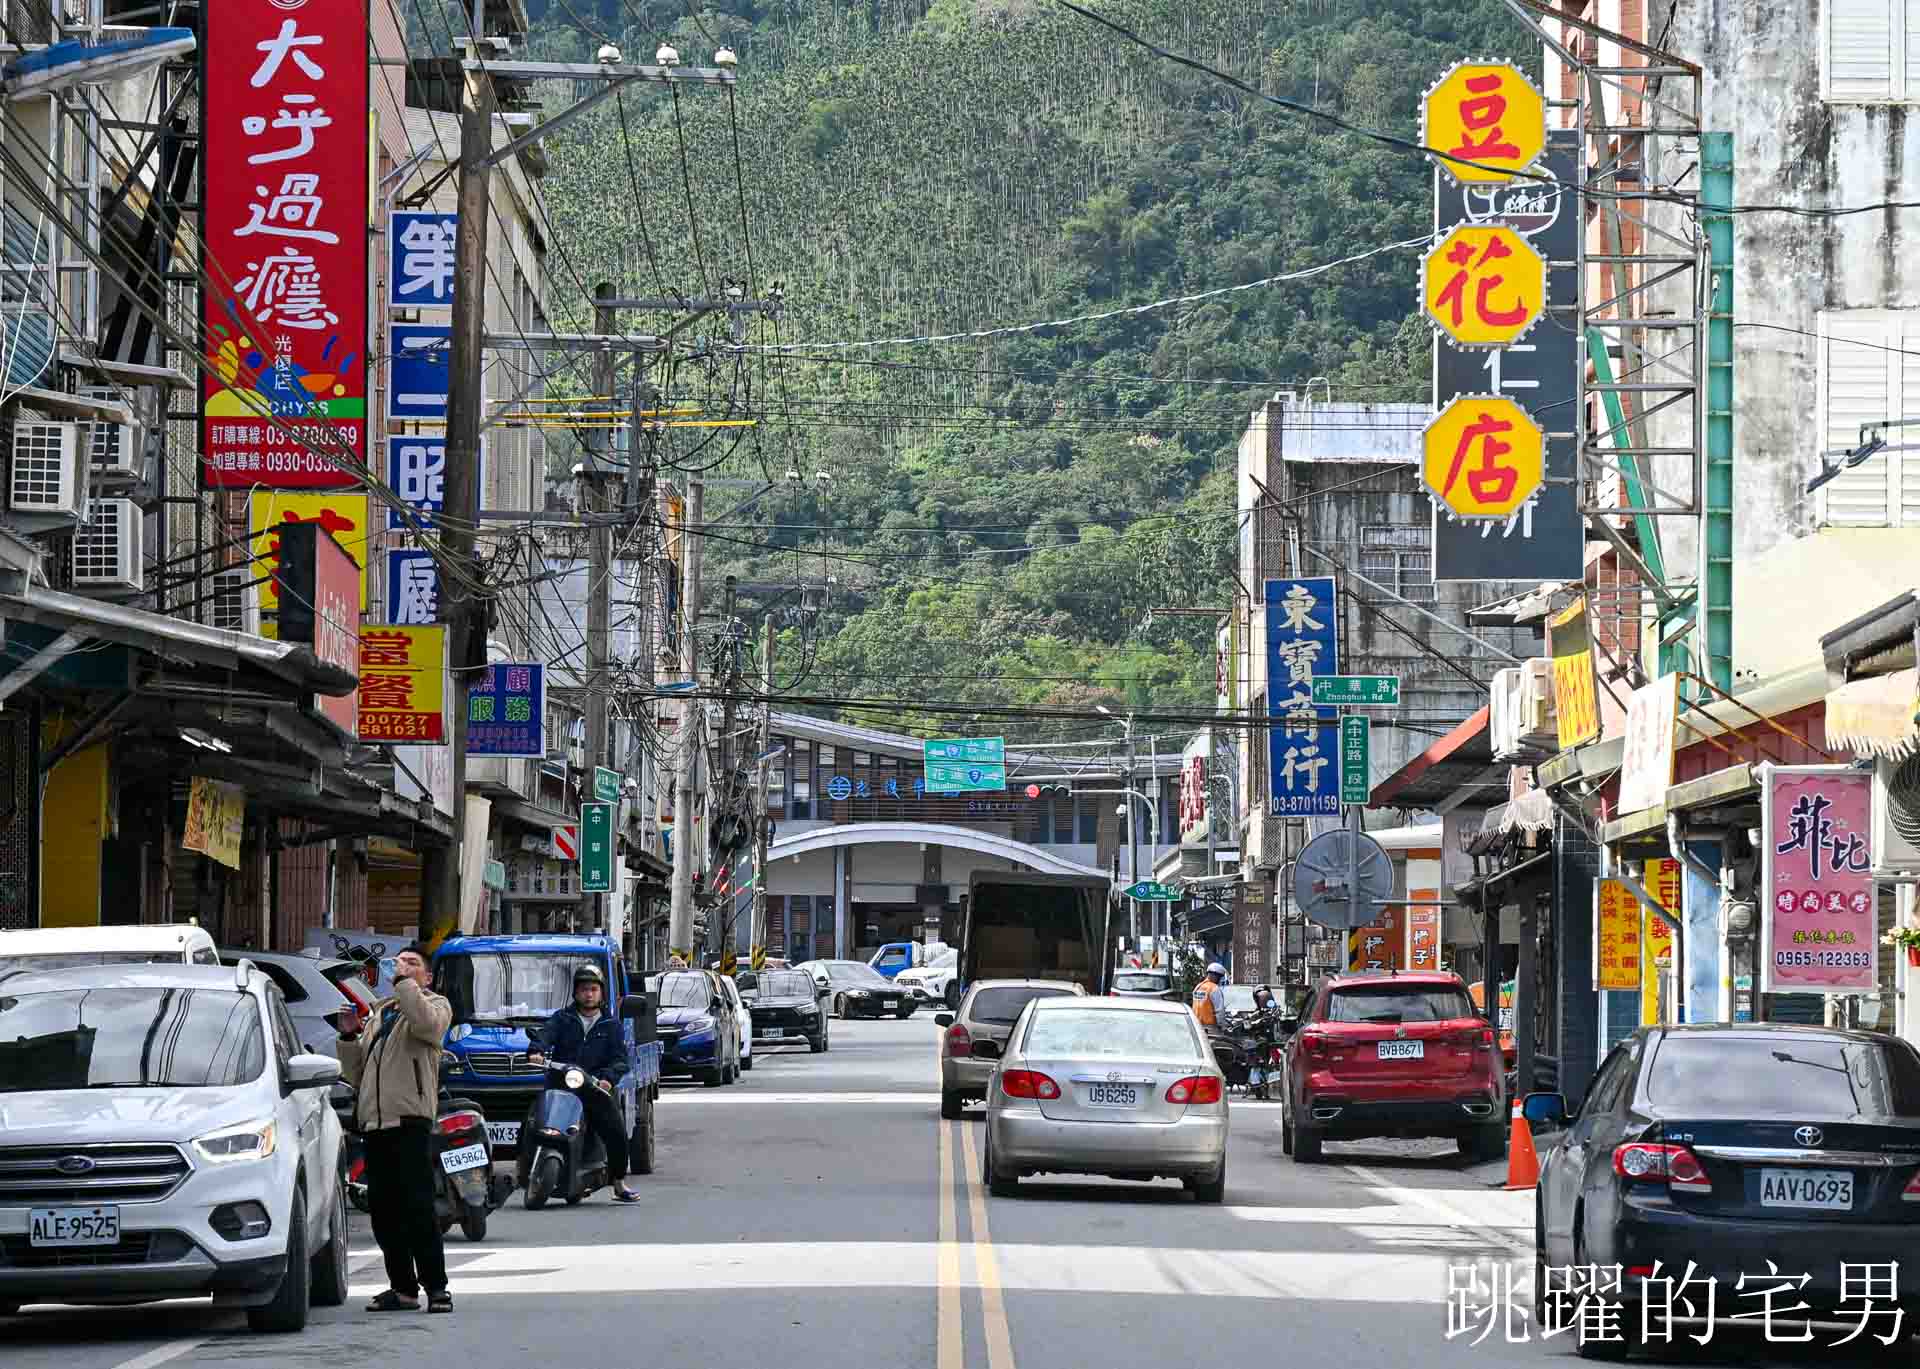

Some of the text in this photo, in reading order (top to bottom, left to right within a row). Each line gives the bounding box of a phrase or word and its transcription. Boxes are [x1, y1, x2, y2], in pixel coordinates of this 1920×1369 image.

[234, 19, 340, 329] 大呼過癮
[1436, 73, 1528, 504] 豆花店
[1278, 583, 1329, 793] 東寶商行
[1320, 680, 1390, 693] 中華路
[359, 714, 429, 726] 00727
[1273, 795, 1338, 813] 03-8701159
[1776, 951, 1870, 966] 0965-122363
[1763, 1177, 1851, 1203] AAV-0693
[32, 1216, 117, 1241] ALE-9525
